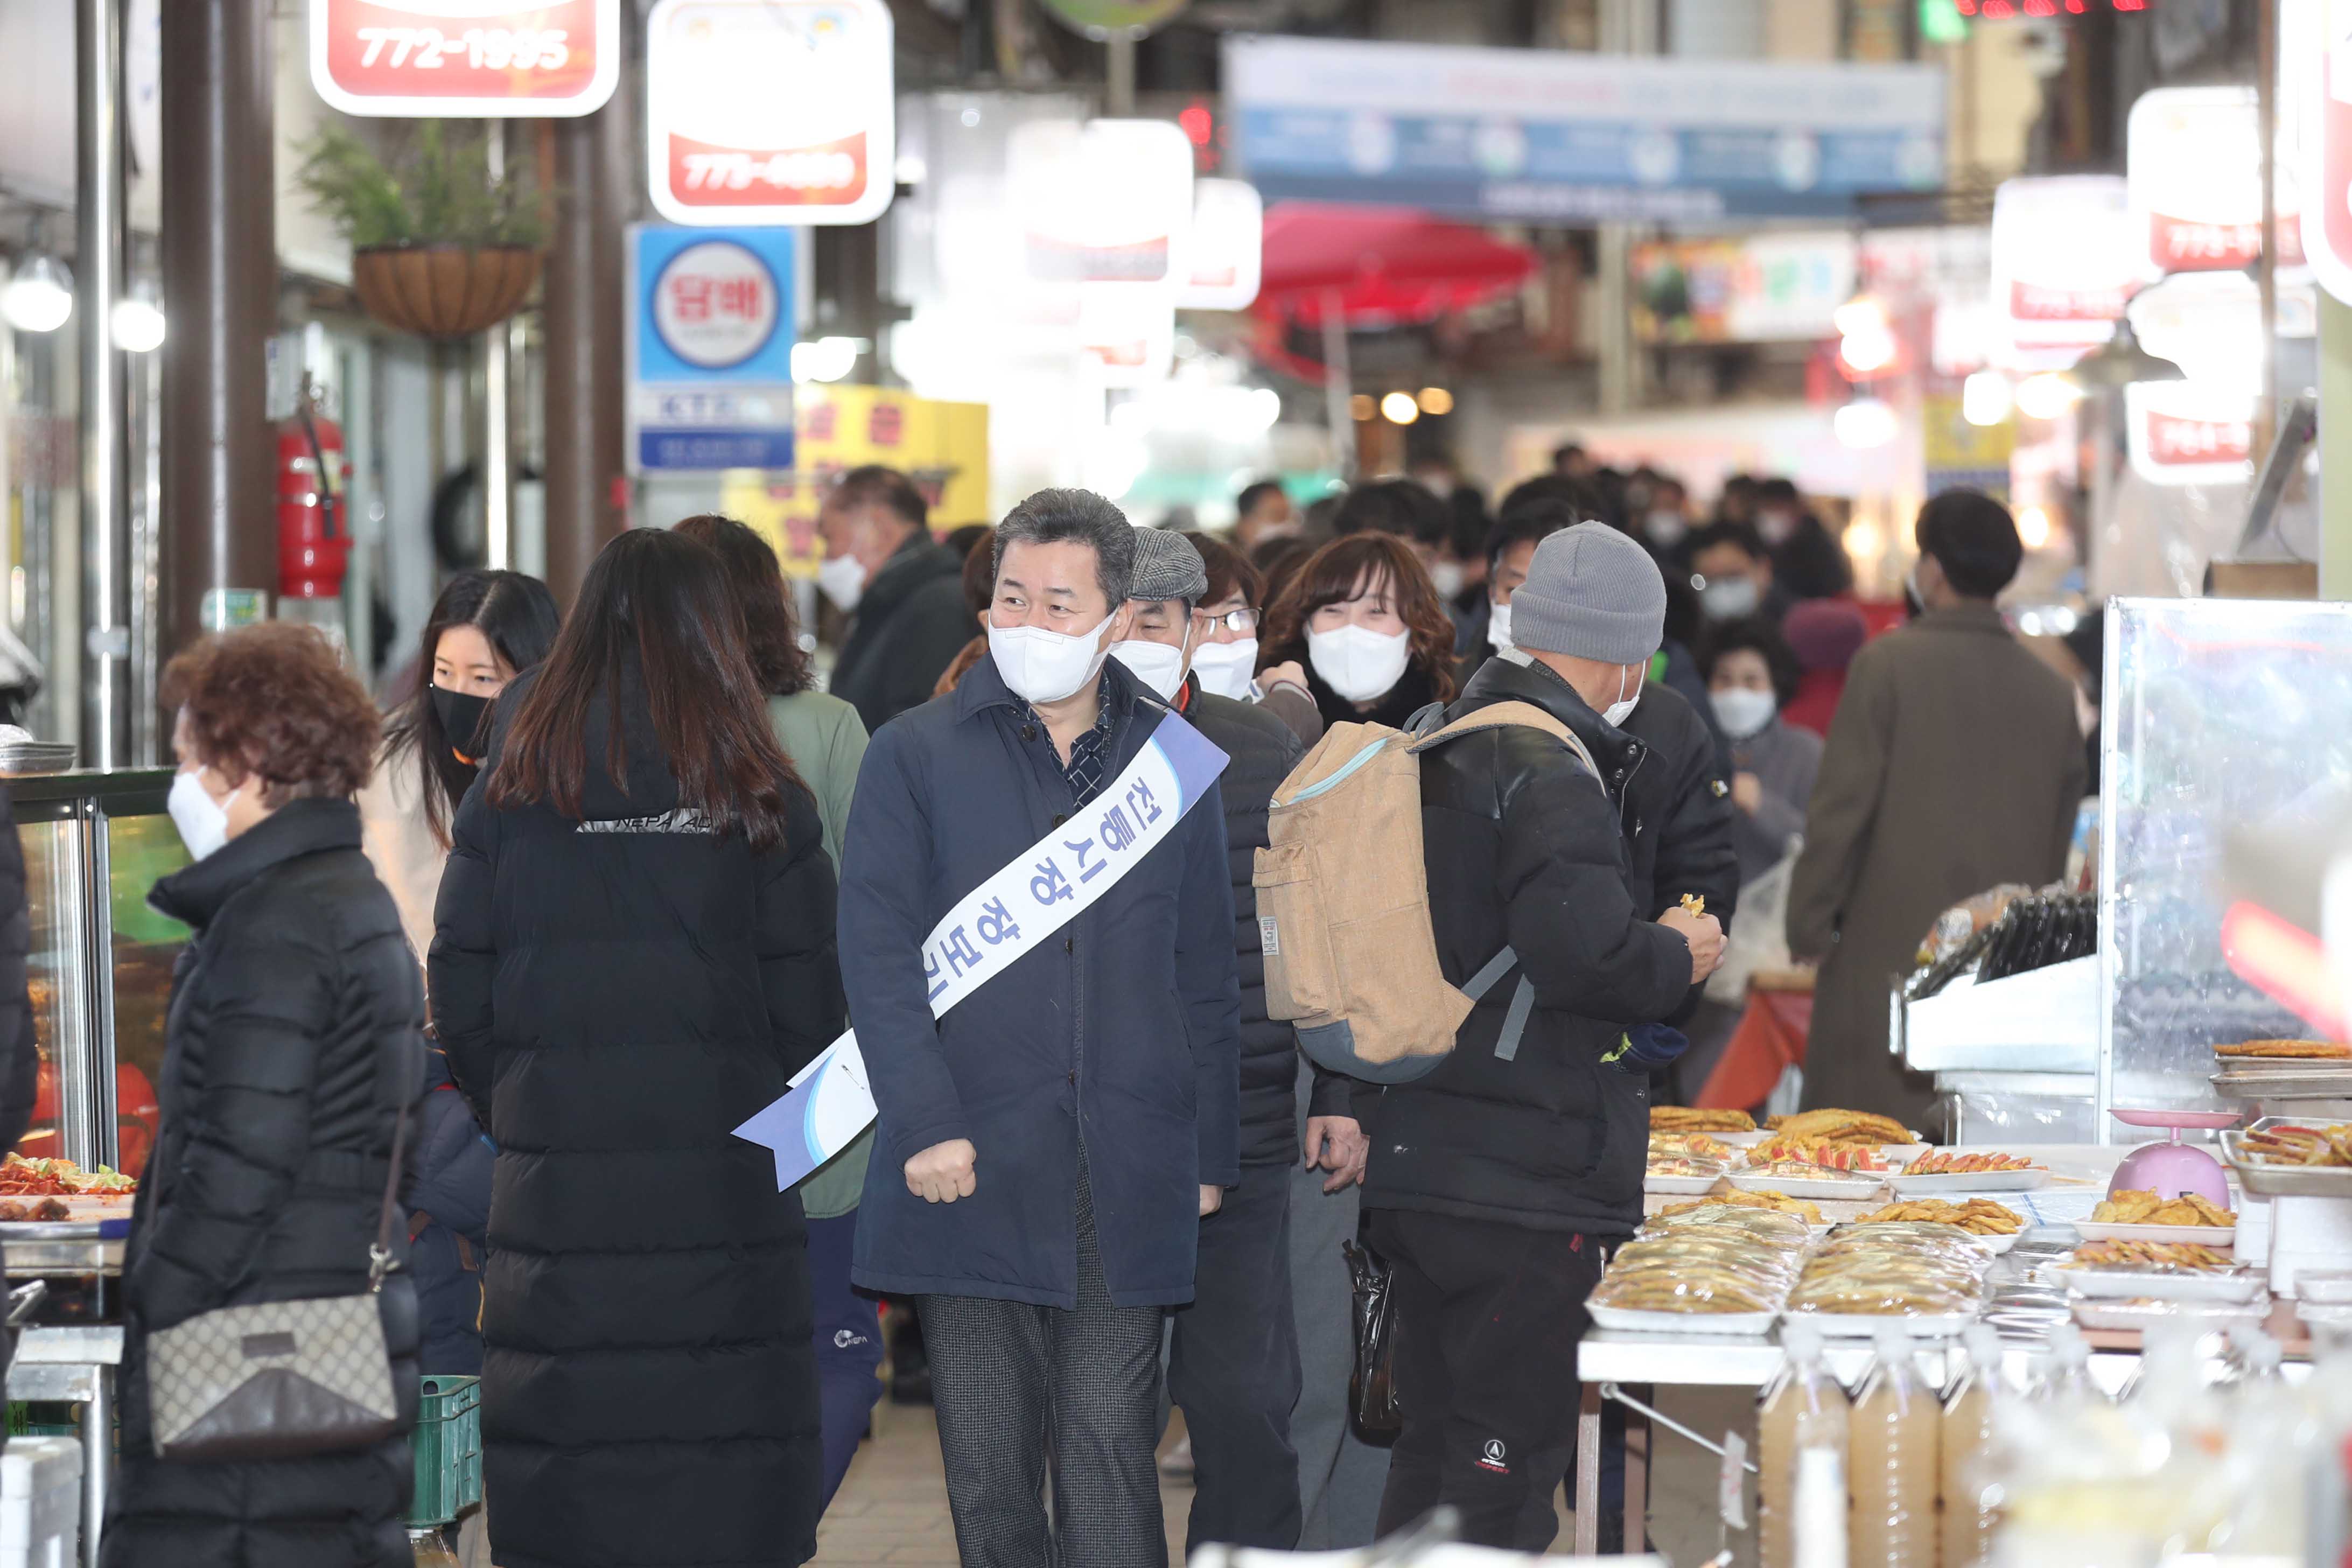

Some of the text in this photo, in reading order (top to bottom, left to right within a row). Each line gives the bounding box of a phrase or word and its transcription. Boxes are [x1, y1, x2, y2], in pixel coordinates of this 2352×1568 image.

[357, 27, 570, 70] 772-1995
[670, 274, 762, 323] 담배
[617, 816, 673, 828] NEPA
[923, 776, 1161, 1003] 전통시장 장보기
